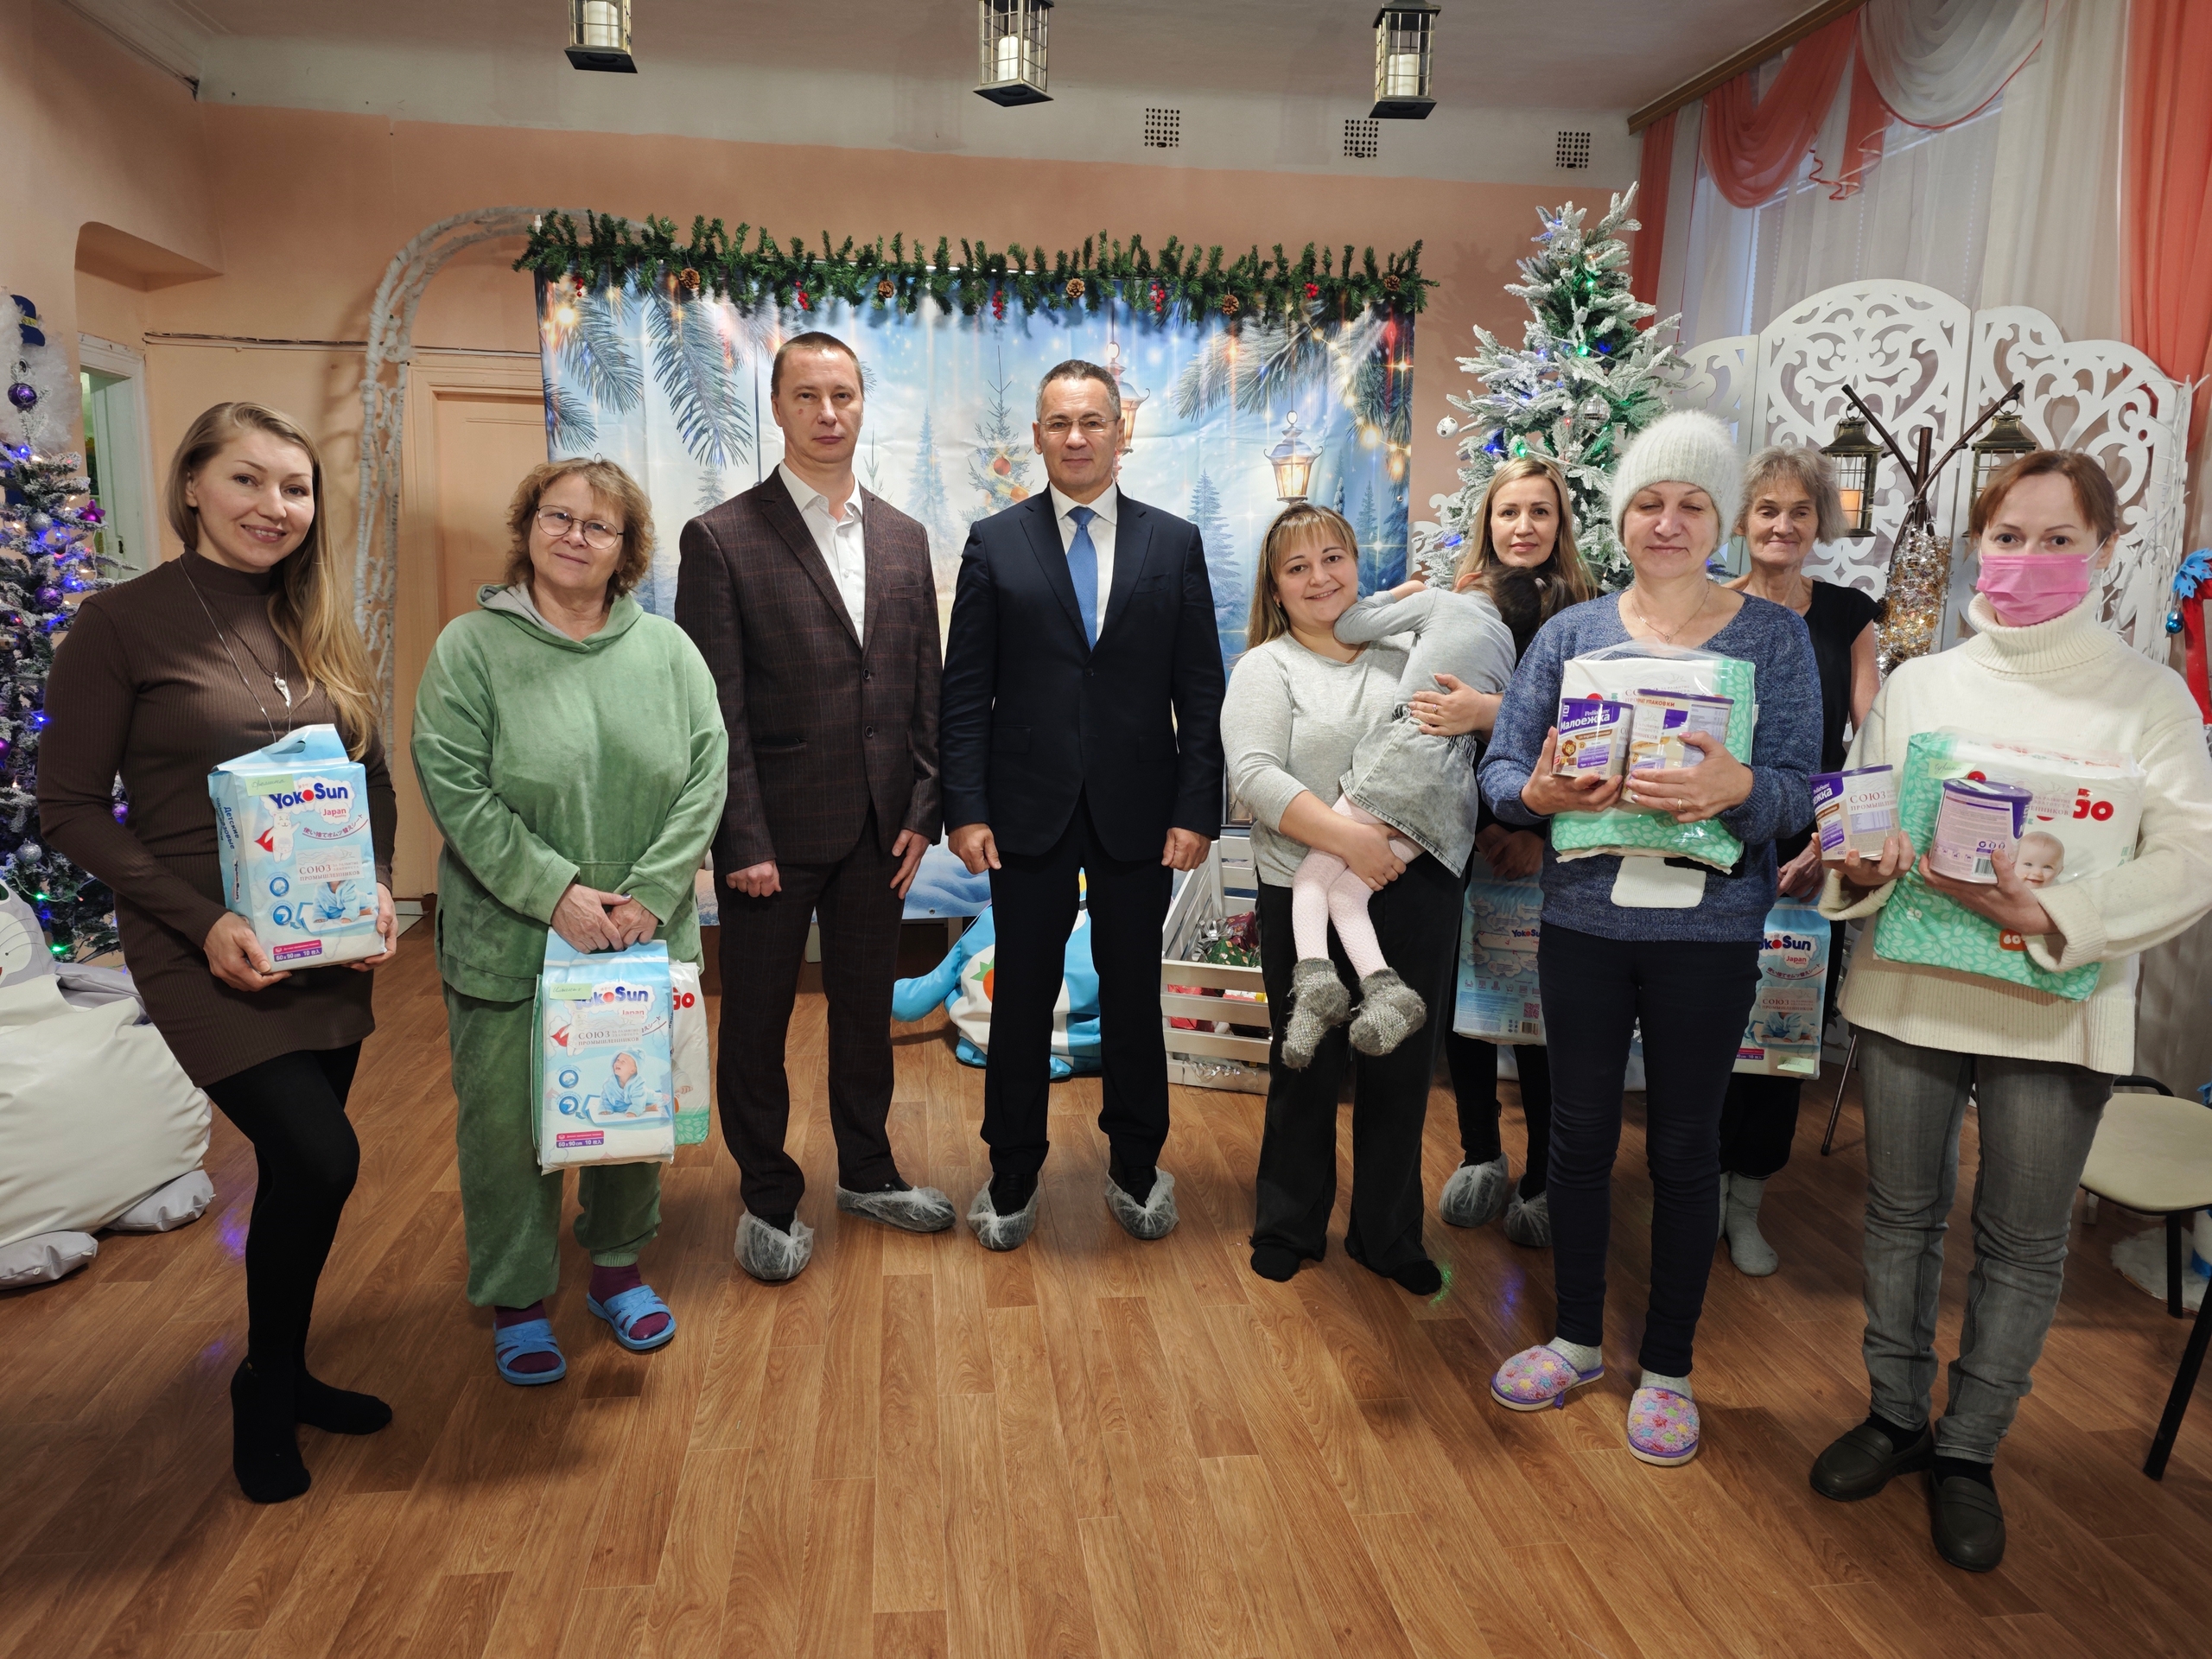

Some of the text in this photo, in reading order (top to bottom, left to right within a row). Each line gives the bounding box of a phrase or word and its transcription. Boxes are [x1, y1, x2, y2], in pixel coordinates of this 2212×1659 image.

[1646, 698, 1675, 708] УПАКОВКИ
[269, 783, 348, 809] YokoSun
[1850, 791, 1885, 804] СОЮЗ
[322, 808, 346, 817] Japan
[224, 806, 240, 839] Детские
[299, 864, 331, 874] СОЮЗ
[299, 870, 360, 881] ПРОМЫШЛЕННИКОВ
[578, 1030, 610, 1040] СОЮЗ
[578, 1037, 639, 1046] ПРОМЫШЛЕННИКОВ
